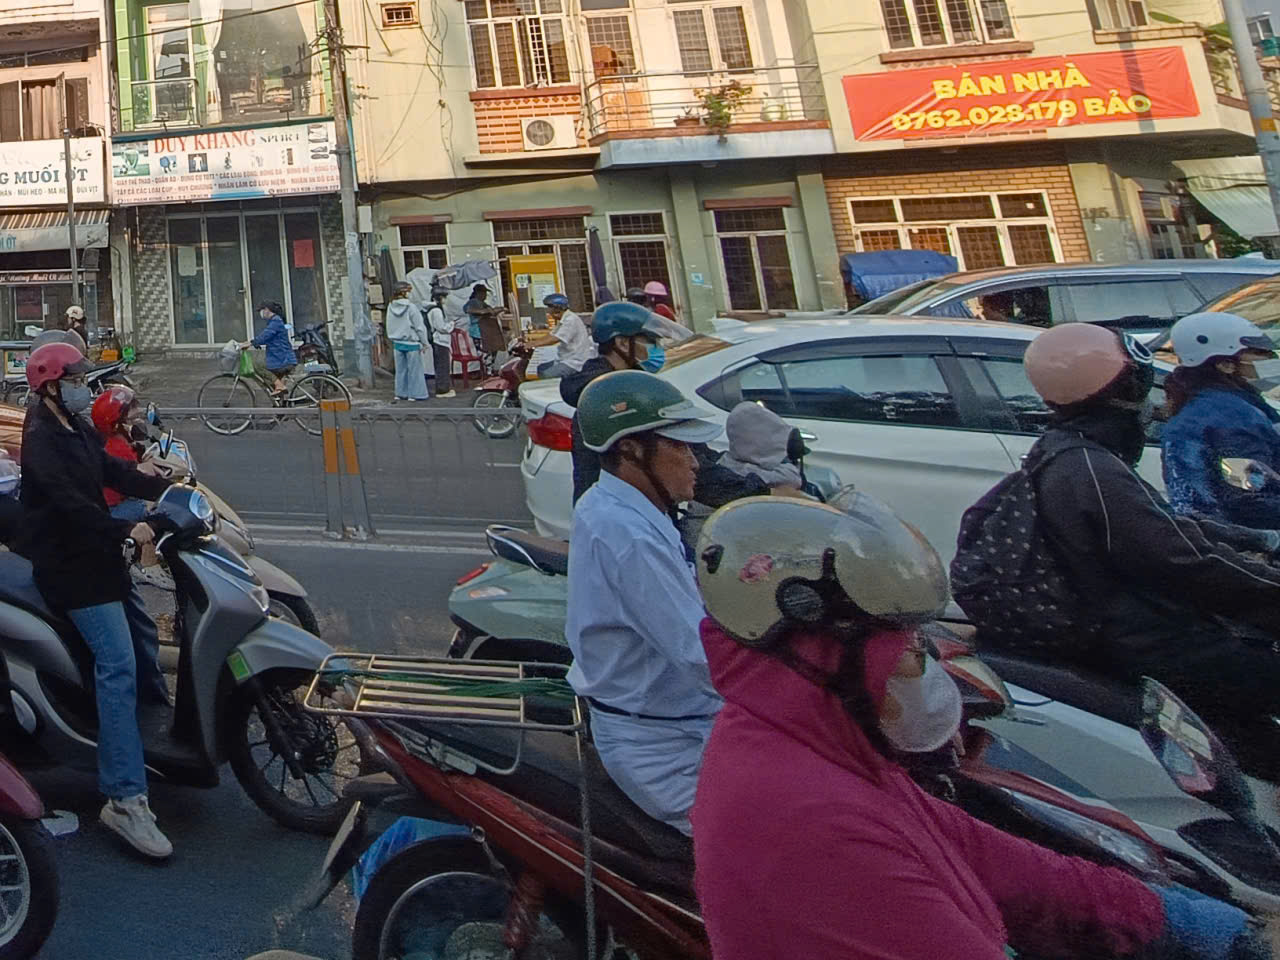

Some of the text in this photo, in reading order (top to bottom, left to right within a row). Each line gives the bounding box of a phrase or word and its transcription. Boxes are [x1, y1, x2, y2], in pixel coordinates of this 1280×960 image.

[932, 62, 1092, 100] BÁN NHÀ
[891, 89, 1152, 131] 0762.028.179 BẢO
[154, 129, 257, 154] DUY KHANG
[14, 163, 60, 185] MUỐI
